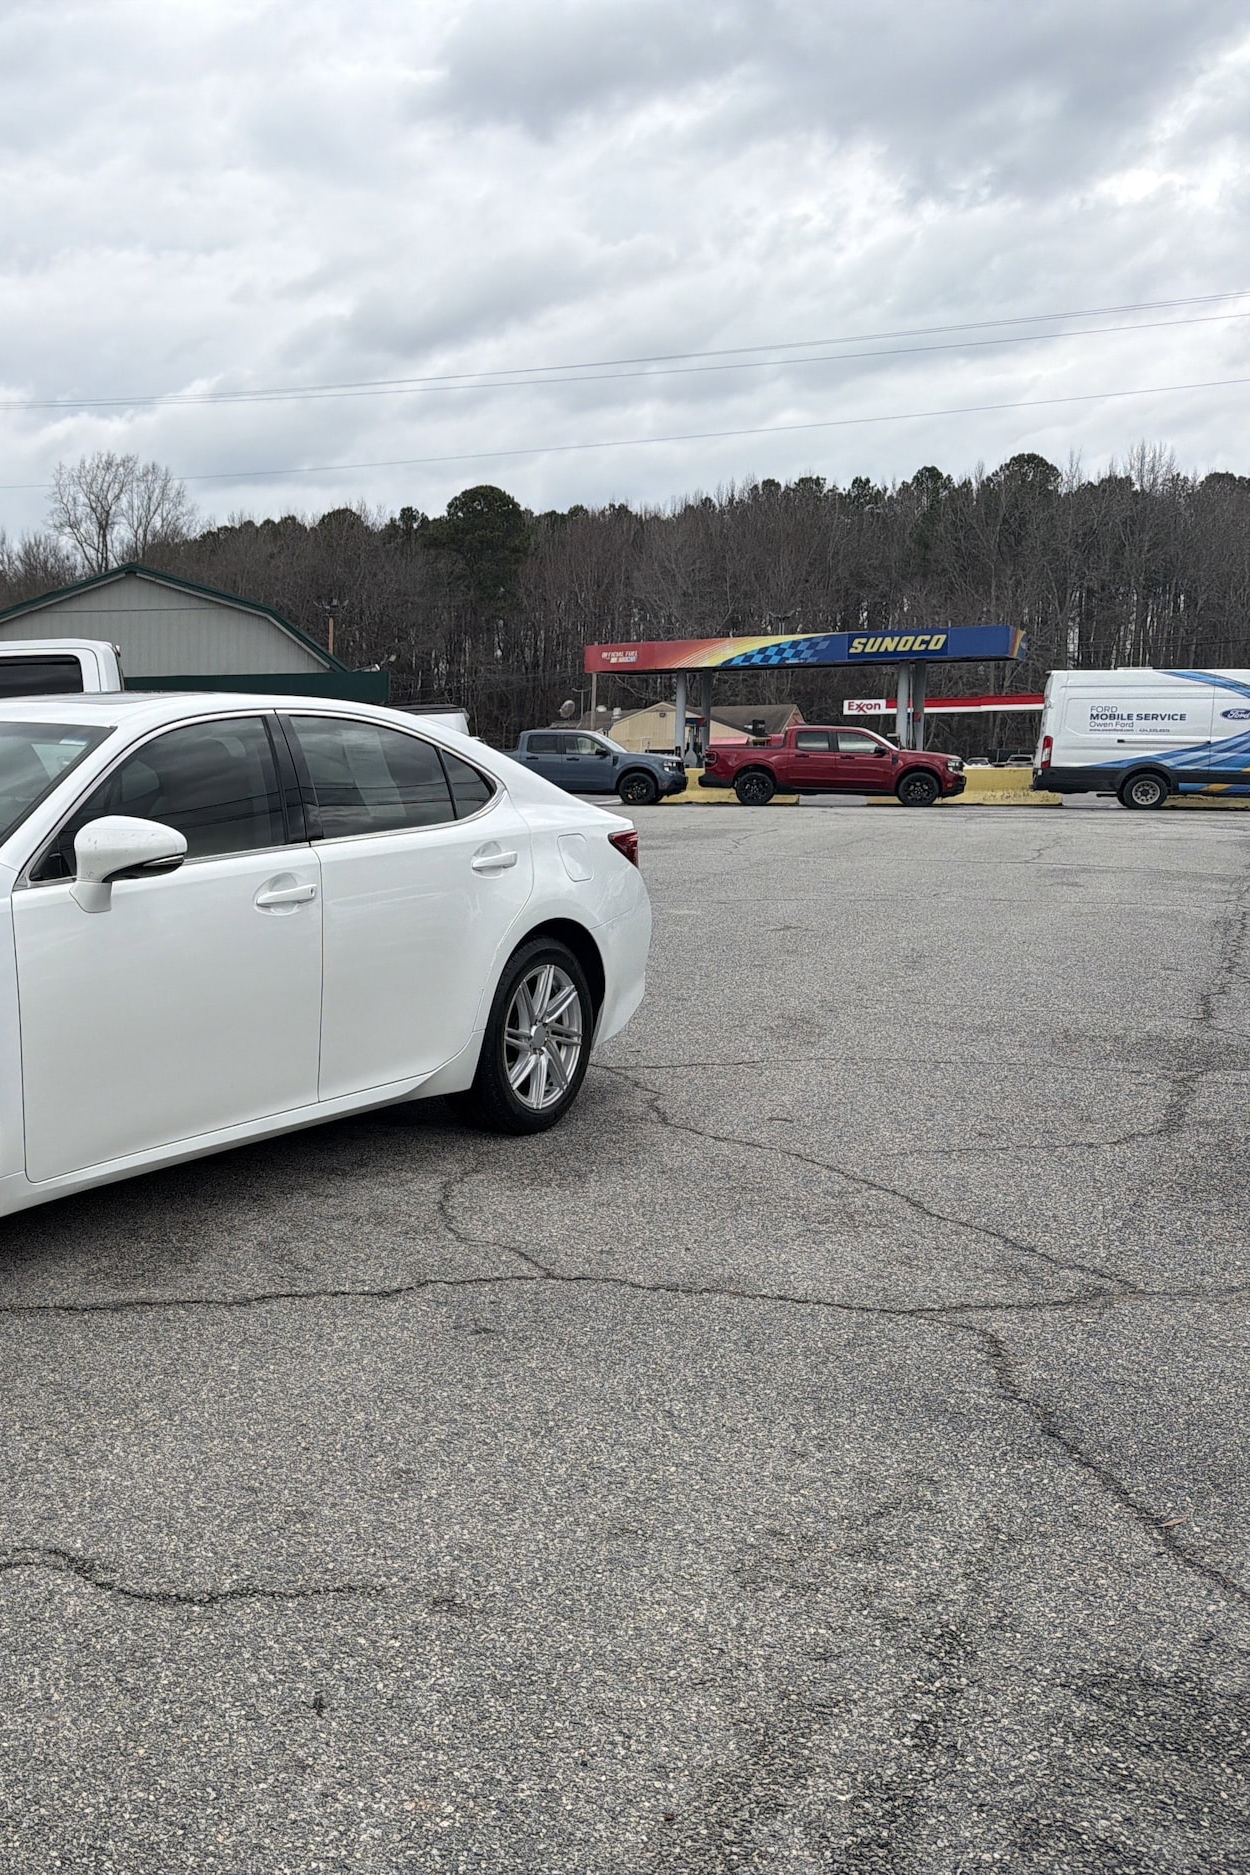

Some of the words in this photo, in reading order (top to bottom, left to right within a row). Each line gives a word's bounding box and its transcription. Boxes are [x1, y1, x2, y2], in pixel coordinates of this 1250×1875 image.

[849, 634, 947, 653] SUNOCO
[848, 701, 881, 713] Exxon
[1089, 713, 1133, 721] MOBILE
[1136, 713, 1187, 721] SERVICE
